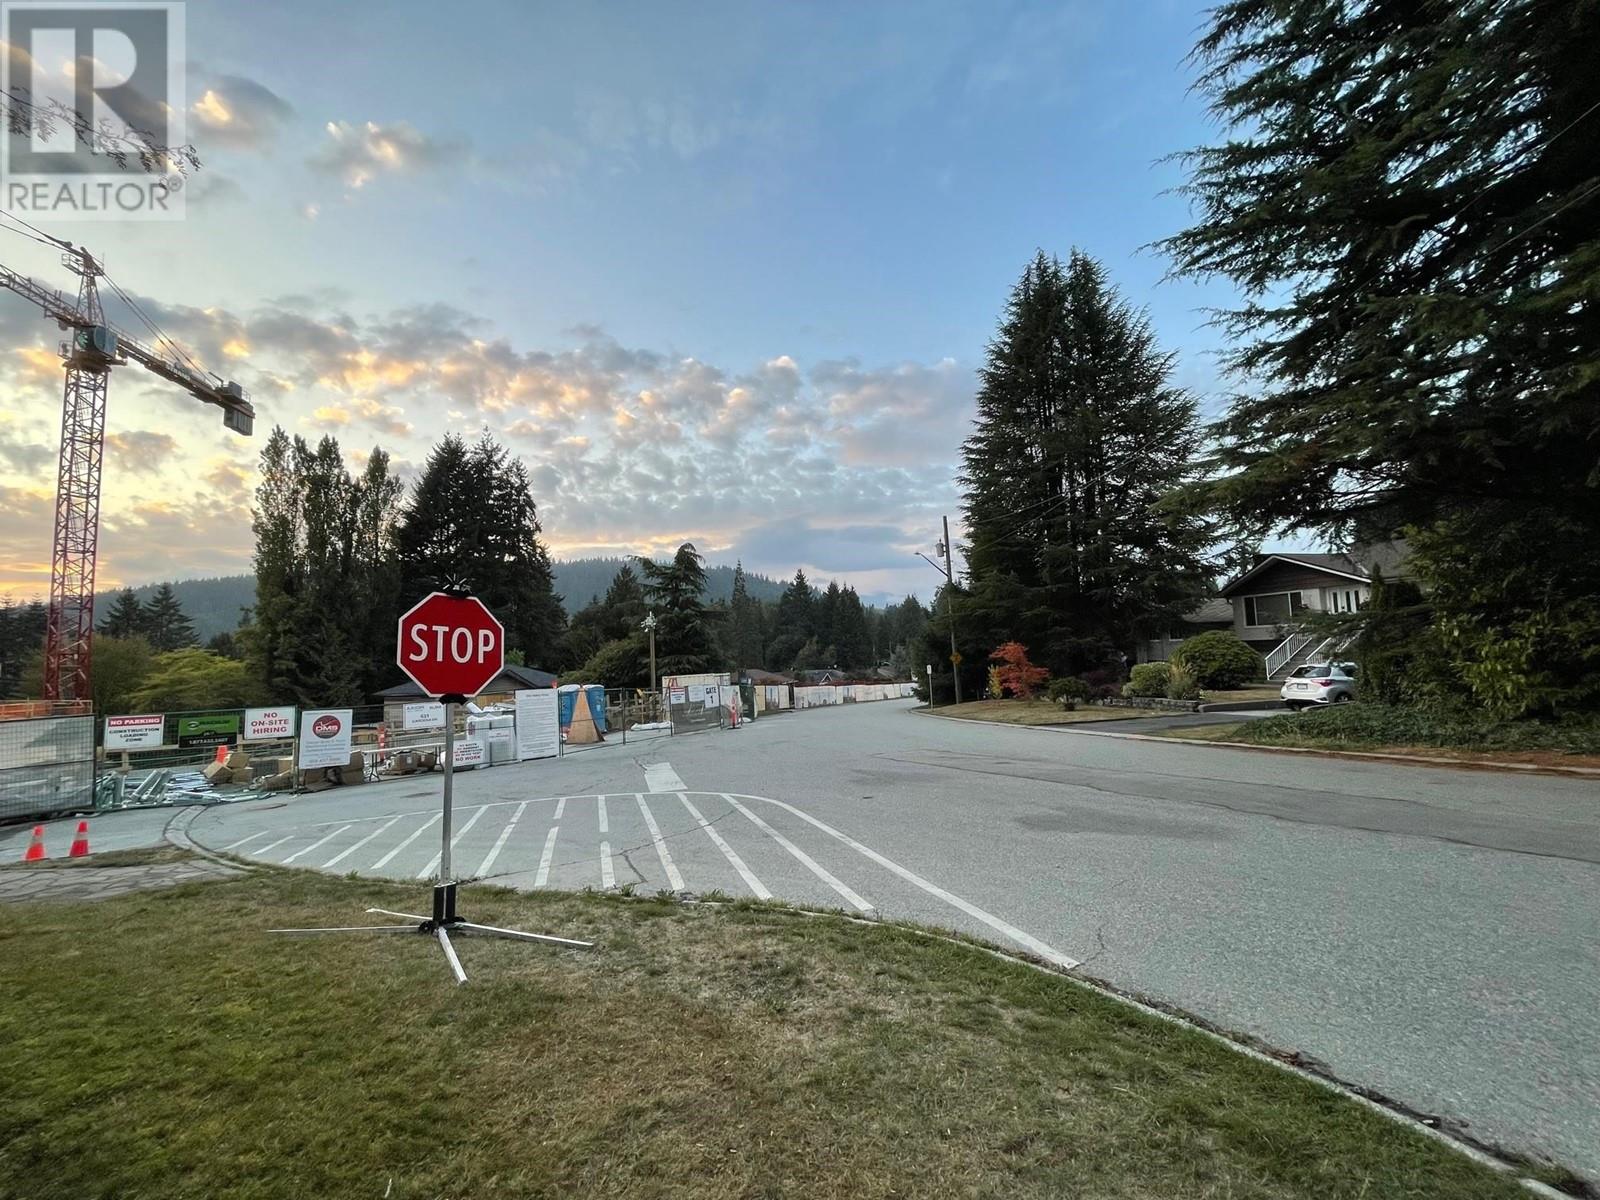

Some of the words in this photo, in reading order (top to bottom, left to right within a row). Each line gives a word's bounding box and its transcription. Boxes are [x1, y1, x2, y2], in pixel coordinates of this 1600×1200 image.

[408, 623, 496, 664] STOP
[706, 686, 717, 695] GATE
[124, 717, 160, 725] PARKING
[251, 719, 289, 727] ON-SITE
[252, 726, 287, 735] HIRING
